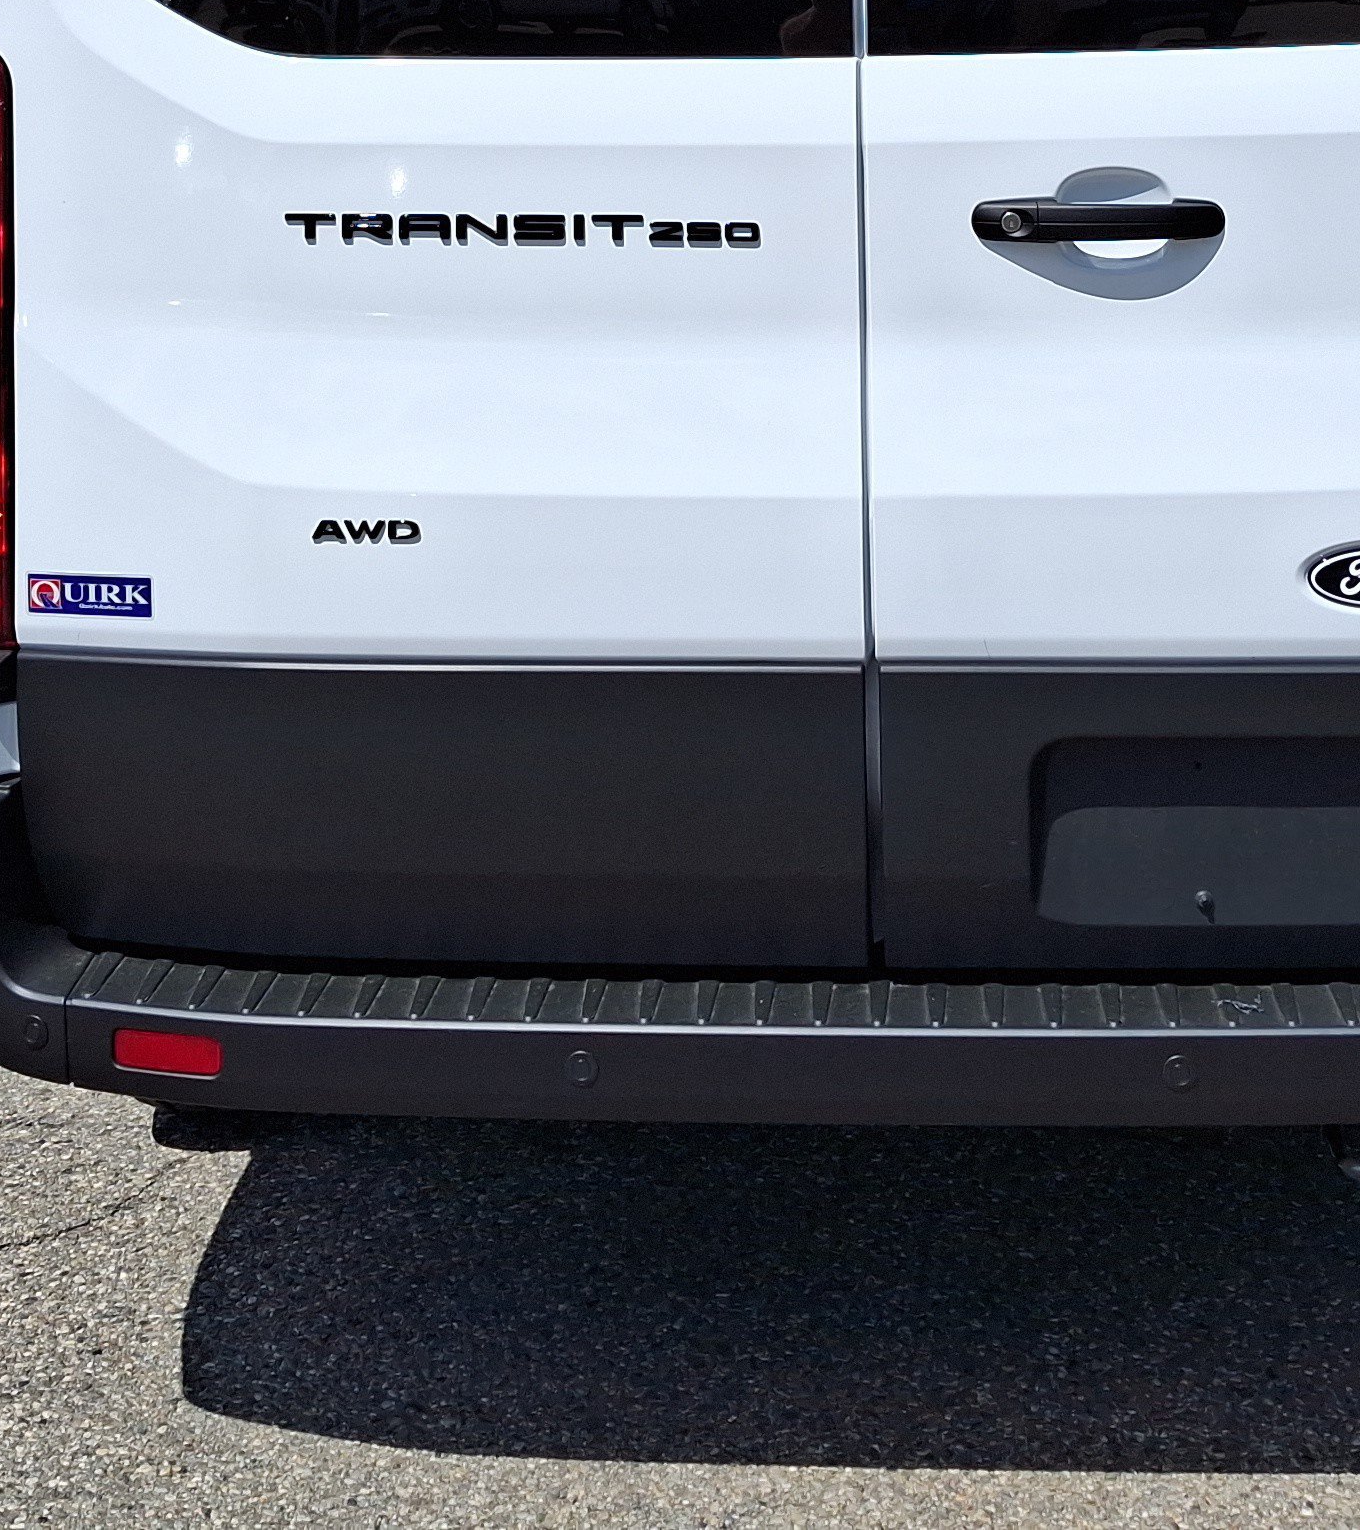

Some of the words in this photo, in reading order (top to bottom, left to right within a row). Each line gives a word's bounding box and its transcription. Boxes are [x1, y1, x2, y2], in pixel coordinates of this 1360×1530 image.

[284, 213, 644, 246] TRANSIT
[648, 221, 761, 248] 250
[311, 519, 422, 545] AWD
[31, 579, 149, 609] QUIRK
